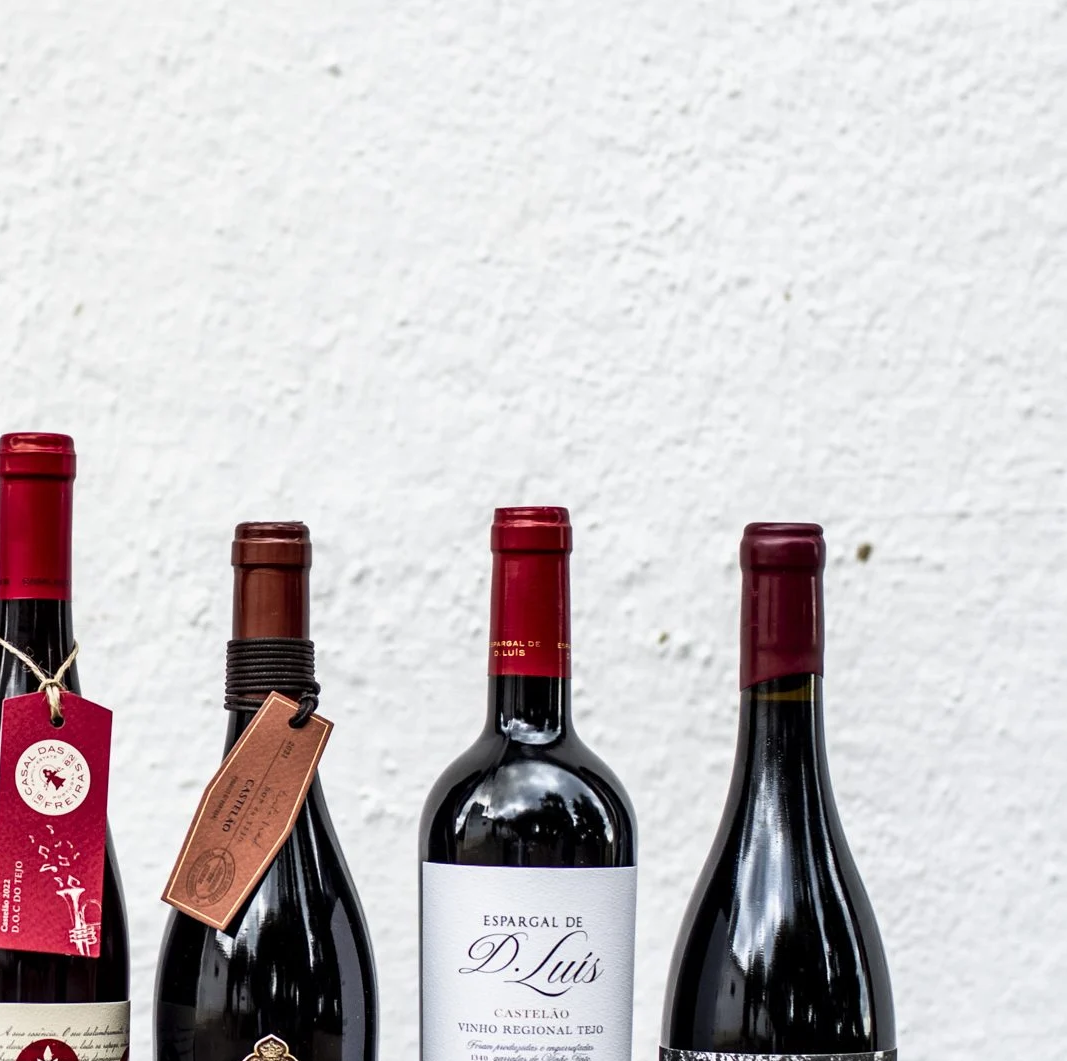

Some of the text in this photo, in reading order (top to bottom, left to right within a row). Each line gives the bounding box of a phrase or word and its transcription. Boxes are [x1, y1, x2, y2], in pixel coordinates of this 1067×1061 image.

[502, 648, 526, 657] LUÍS
[527, 640, 541, 648] DE
[21, 745, 85, 810] CASAL DAS FREIRAS
[221, 778, 255, 833] CASTELÃO
[0, 879, 11, 933] Castelão 2022
[11, 860, 24, 933] D.O.C DO TEJO
[483, 915, 583, 928] ESPARGAL DE
[458, 930, 605, 997] D. Luís
[458, 1022, 604, 1035] VINHO REGIONAL TEJO
[494, 1008, 570, 1019] CASTELÃO
